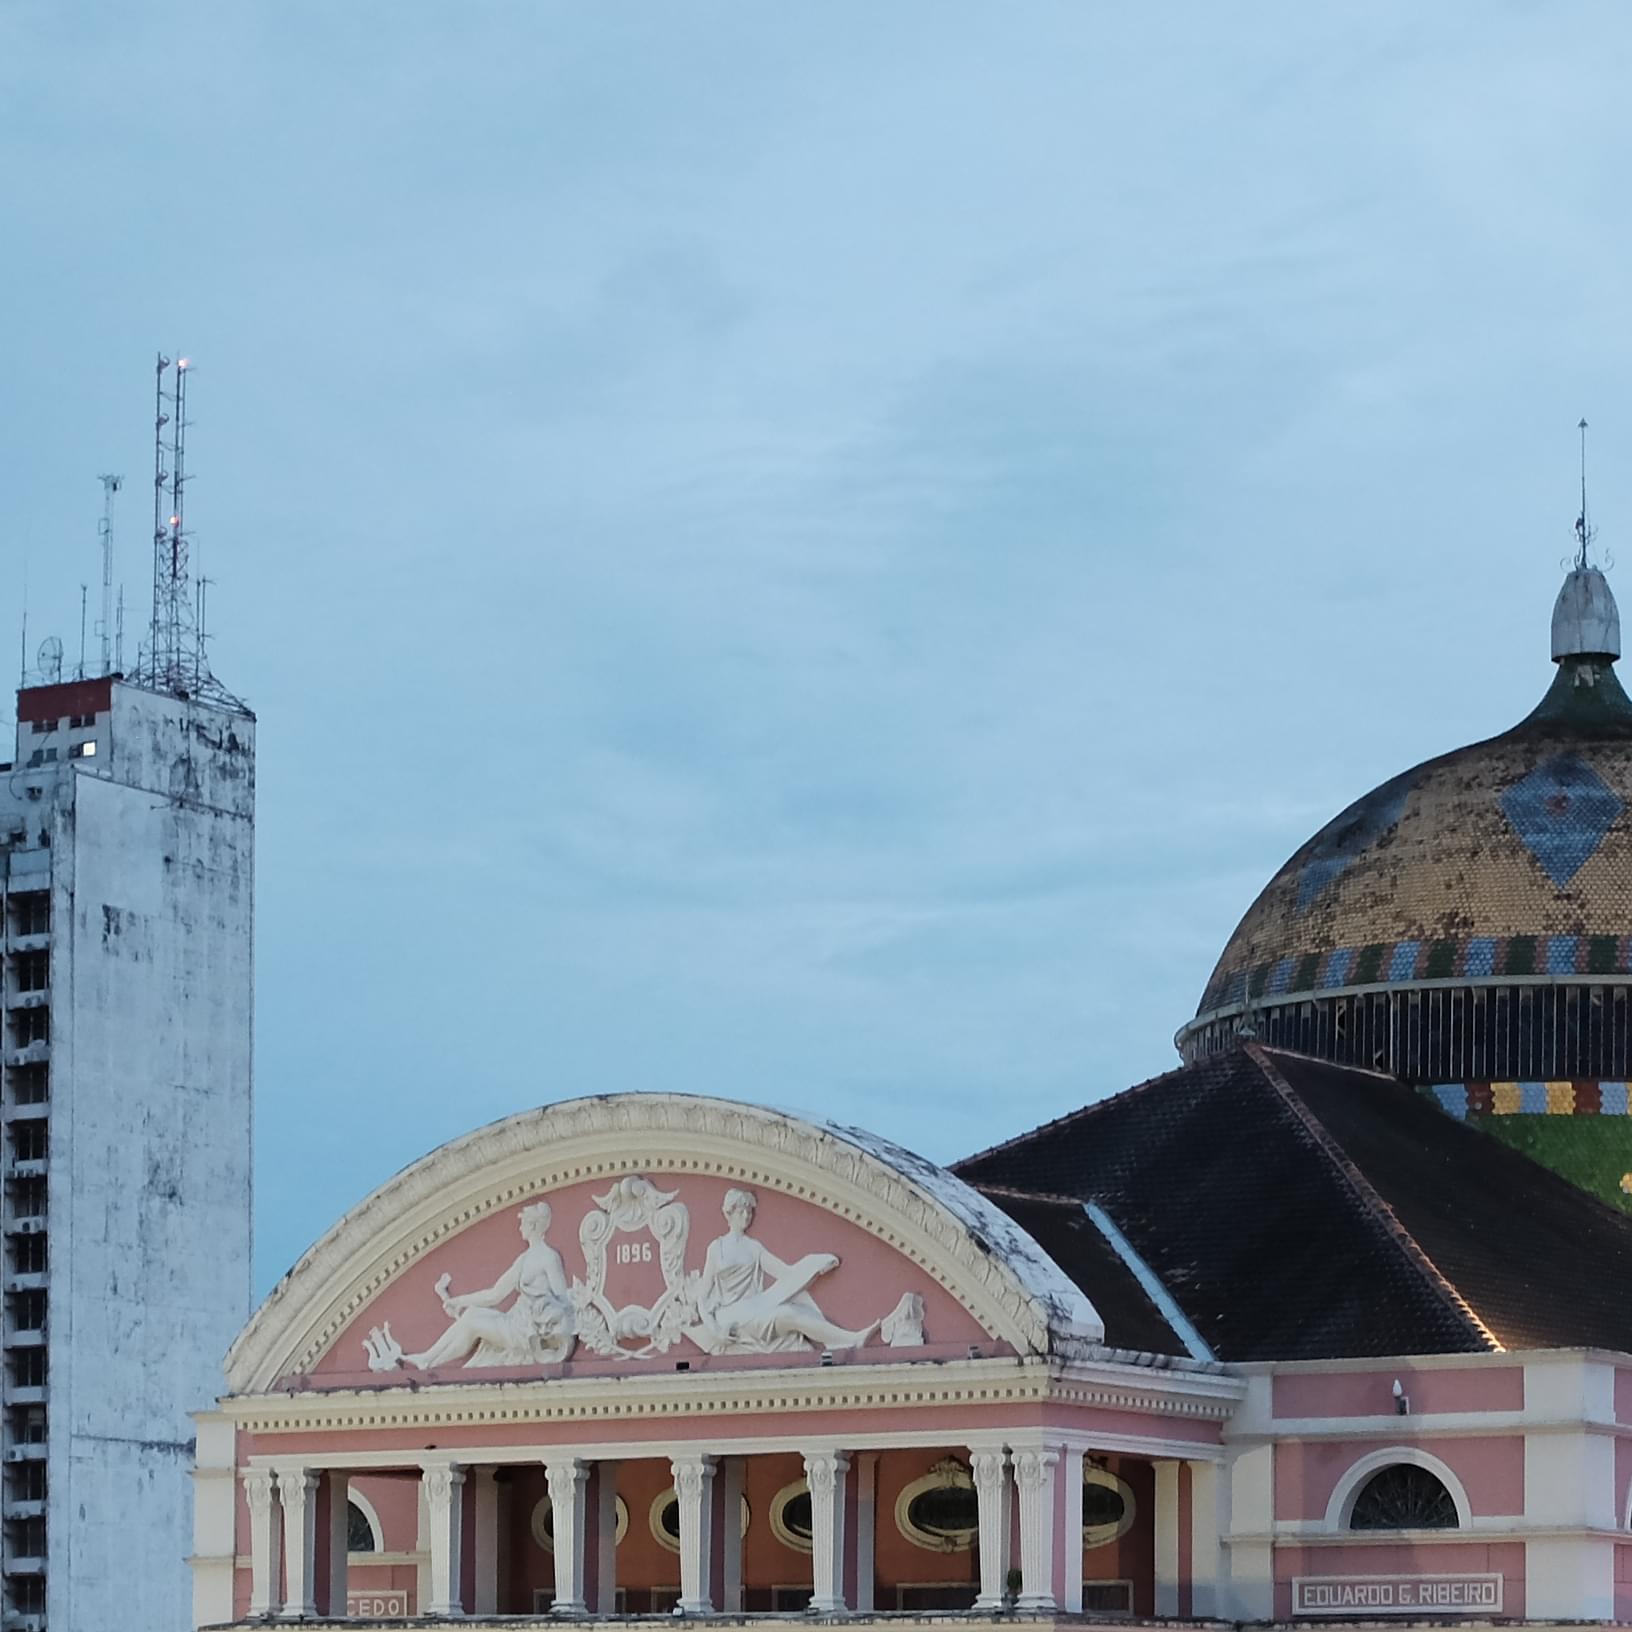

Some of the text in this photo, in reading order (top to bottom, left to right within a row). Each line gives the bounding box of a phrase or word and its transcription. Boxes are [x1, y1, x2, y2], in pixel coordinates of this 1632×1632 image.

[616, 1242, 652, 1264] 1896
[1303, 1582, 1496, 1606] EDUARDO G. RIBEIRO
